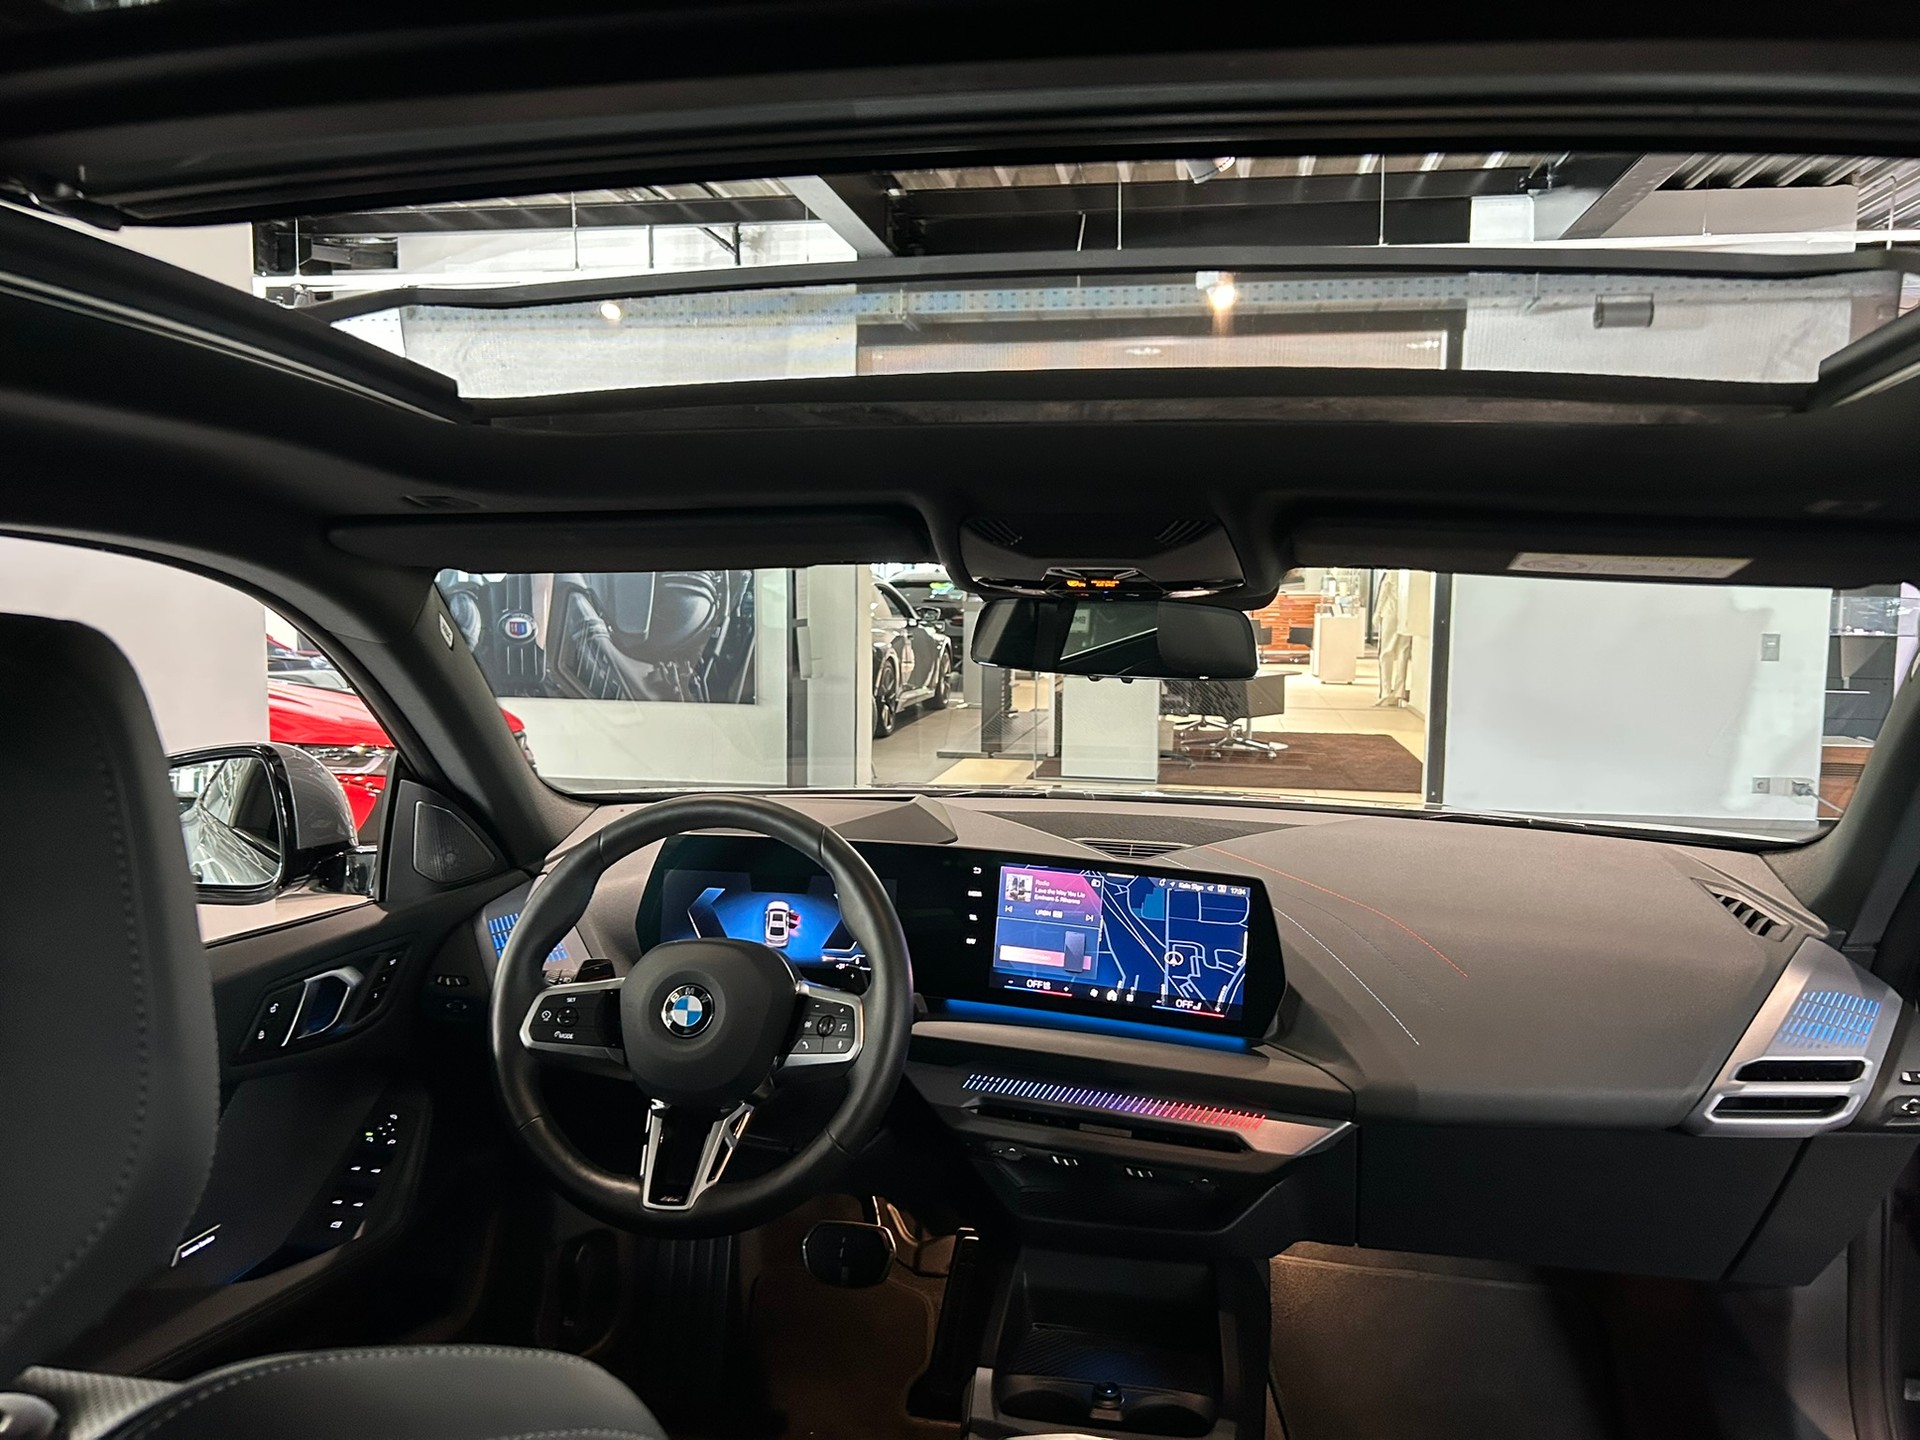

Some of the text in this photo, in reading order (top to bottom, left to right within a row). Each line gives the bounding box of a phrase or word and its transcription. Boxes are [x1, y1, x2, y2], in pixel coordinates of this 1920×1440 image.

[1026, 979, 1043, 989] OFF
[670, 986, 709, 1004] BMW
[1175, 998, 1194, 1009] OFF
[560, 1032, 574, 1040] MODE
